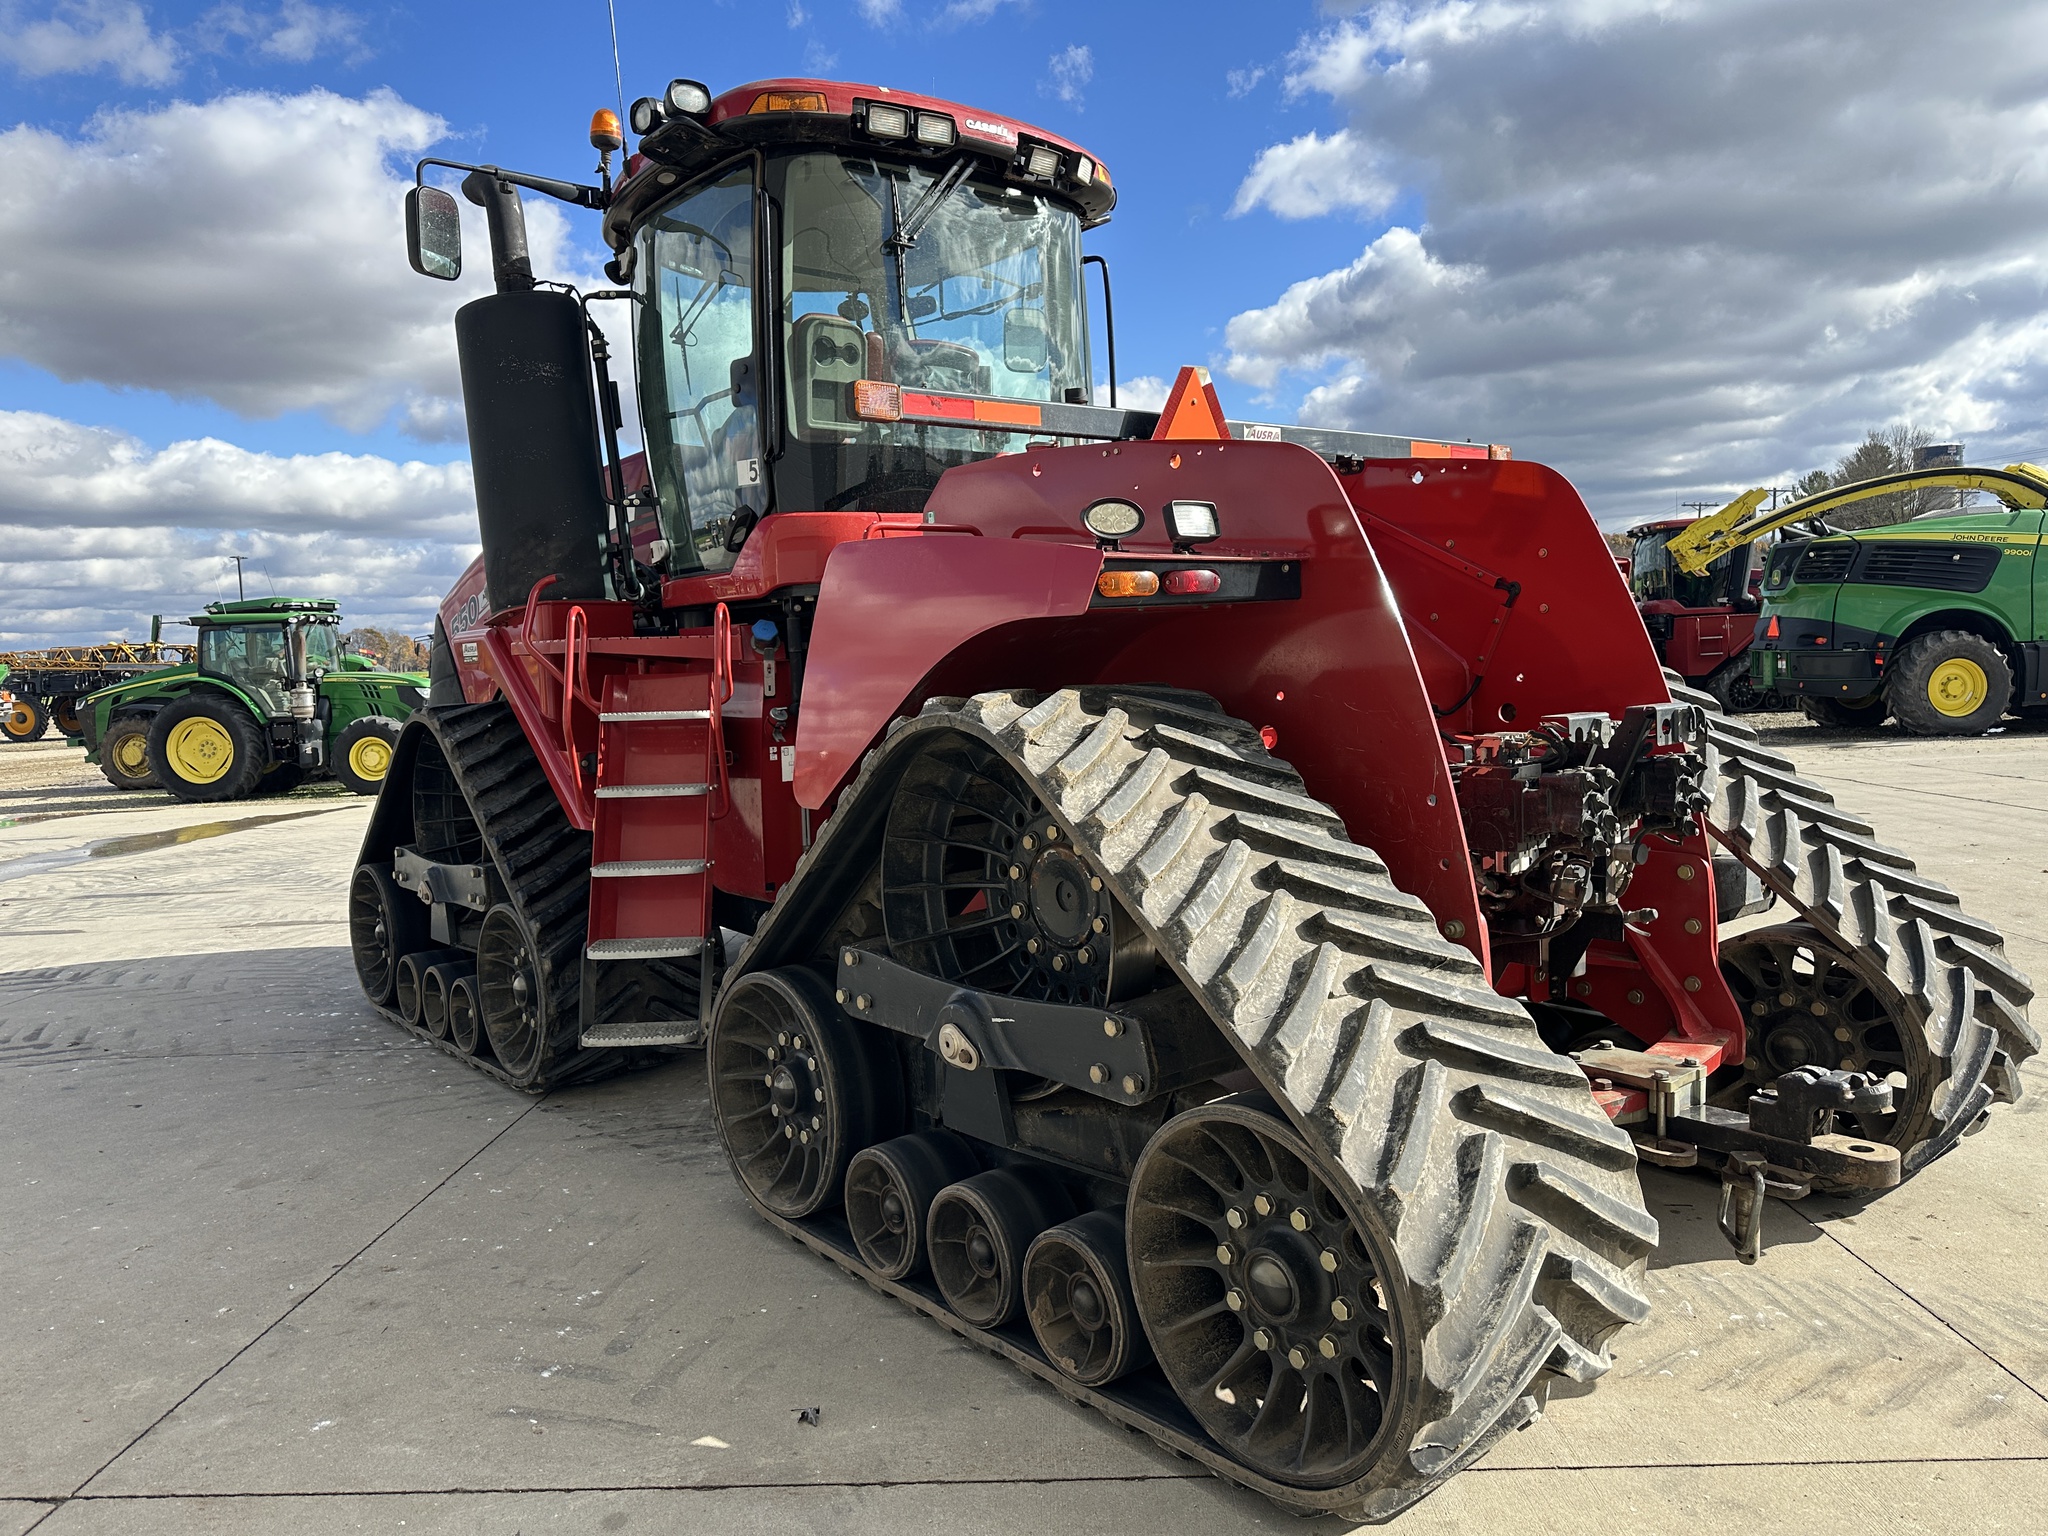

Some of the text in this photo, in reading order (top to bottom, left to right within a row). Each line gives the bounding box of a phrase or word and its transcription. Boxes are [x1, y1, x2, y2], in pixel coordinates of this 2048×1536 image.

[1952, 533, 2009, 543] JOHN DEERE
[2004, 548, 2033, 556] 9900i
[451, 594, 479, 637] 550
